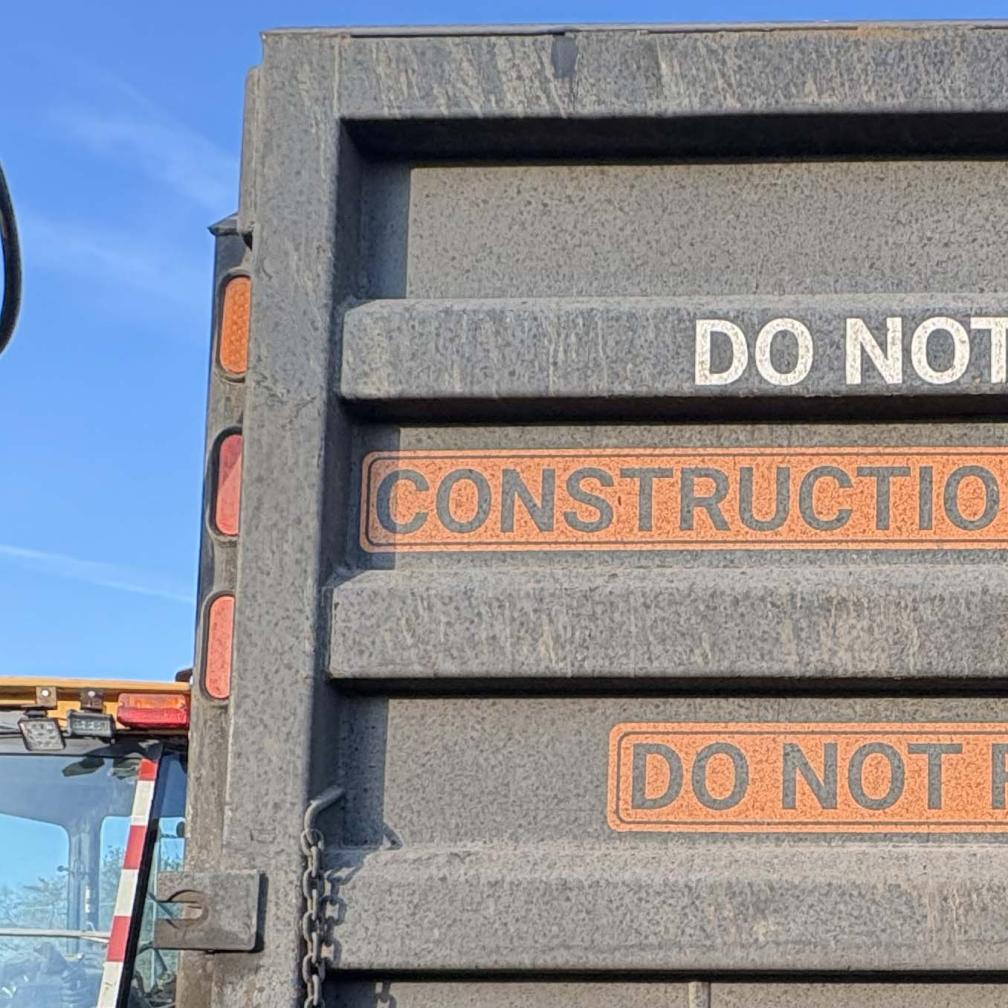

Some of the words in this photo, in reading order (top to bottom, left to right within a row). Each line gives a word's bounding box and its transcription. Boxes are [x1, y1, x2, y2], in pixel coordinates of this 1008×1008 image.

[694, 317, 814, 387] DO
[631, 742, 749, 812] DO
[782, 742, 963, 812] NOT
